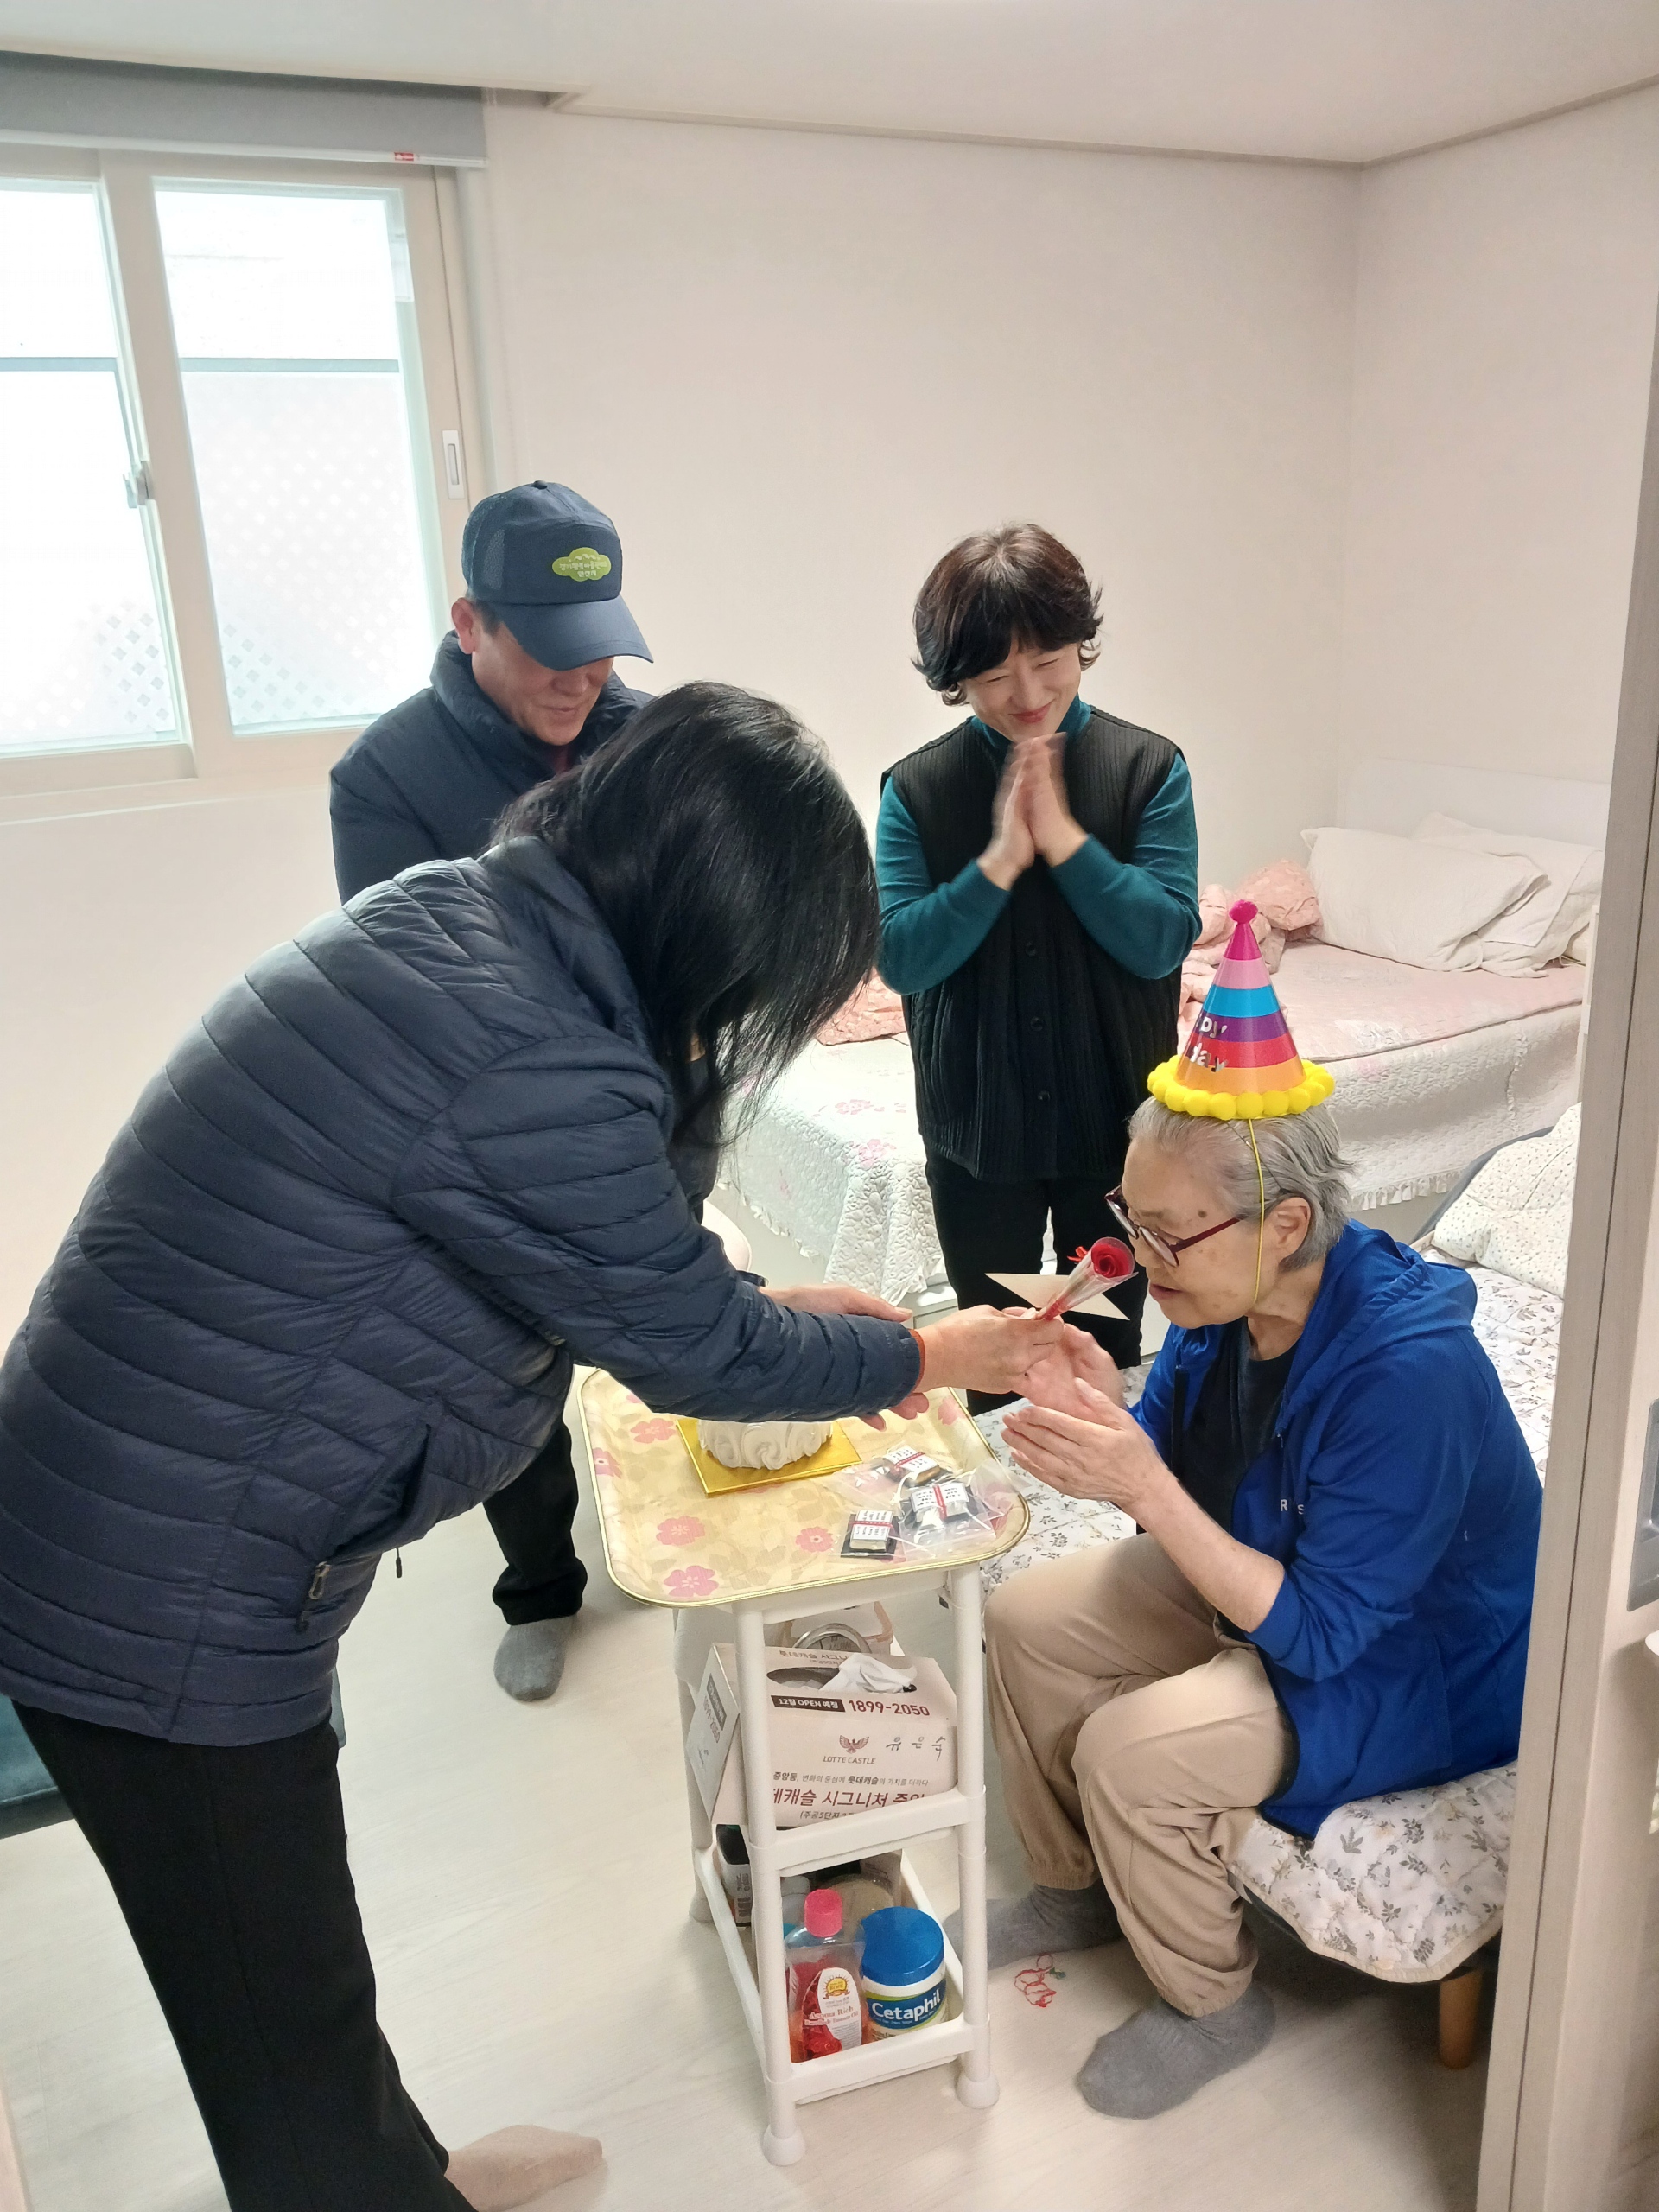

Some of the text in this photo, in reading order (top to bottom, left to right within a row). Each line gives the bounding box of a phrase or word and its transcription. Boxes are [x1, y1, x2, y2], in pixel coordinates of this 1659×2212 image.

[778, 1698, 839, 1709] 12월 OPEN 예정
[848, 1700, 931, 1717] 1899-2050
[802, 1774, 823, 1783] 변화의
[824, 1775, 846, 1783] 중심에
[847, 1776, 886, 1785] 롯데캐슬의
[887, 1777, 907, 1786] 가치를
[821, 1790, 889, 1808] 시그니처
[837, 2005, 854, 2016] Rich
[871, 1988, 941, 2022] Cetaphil
